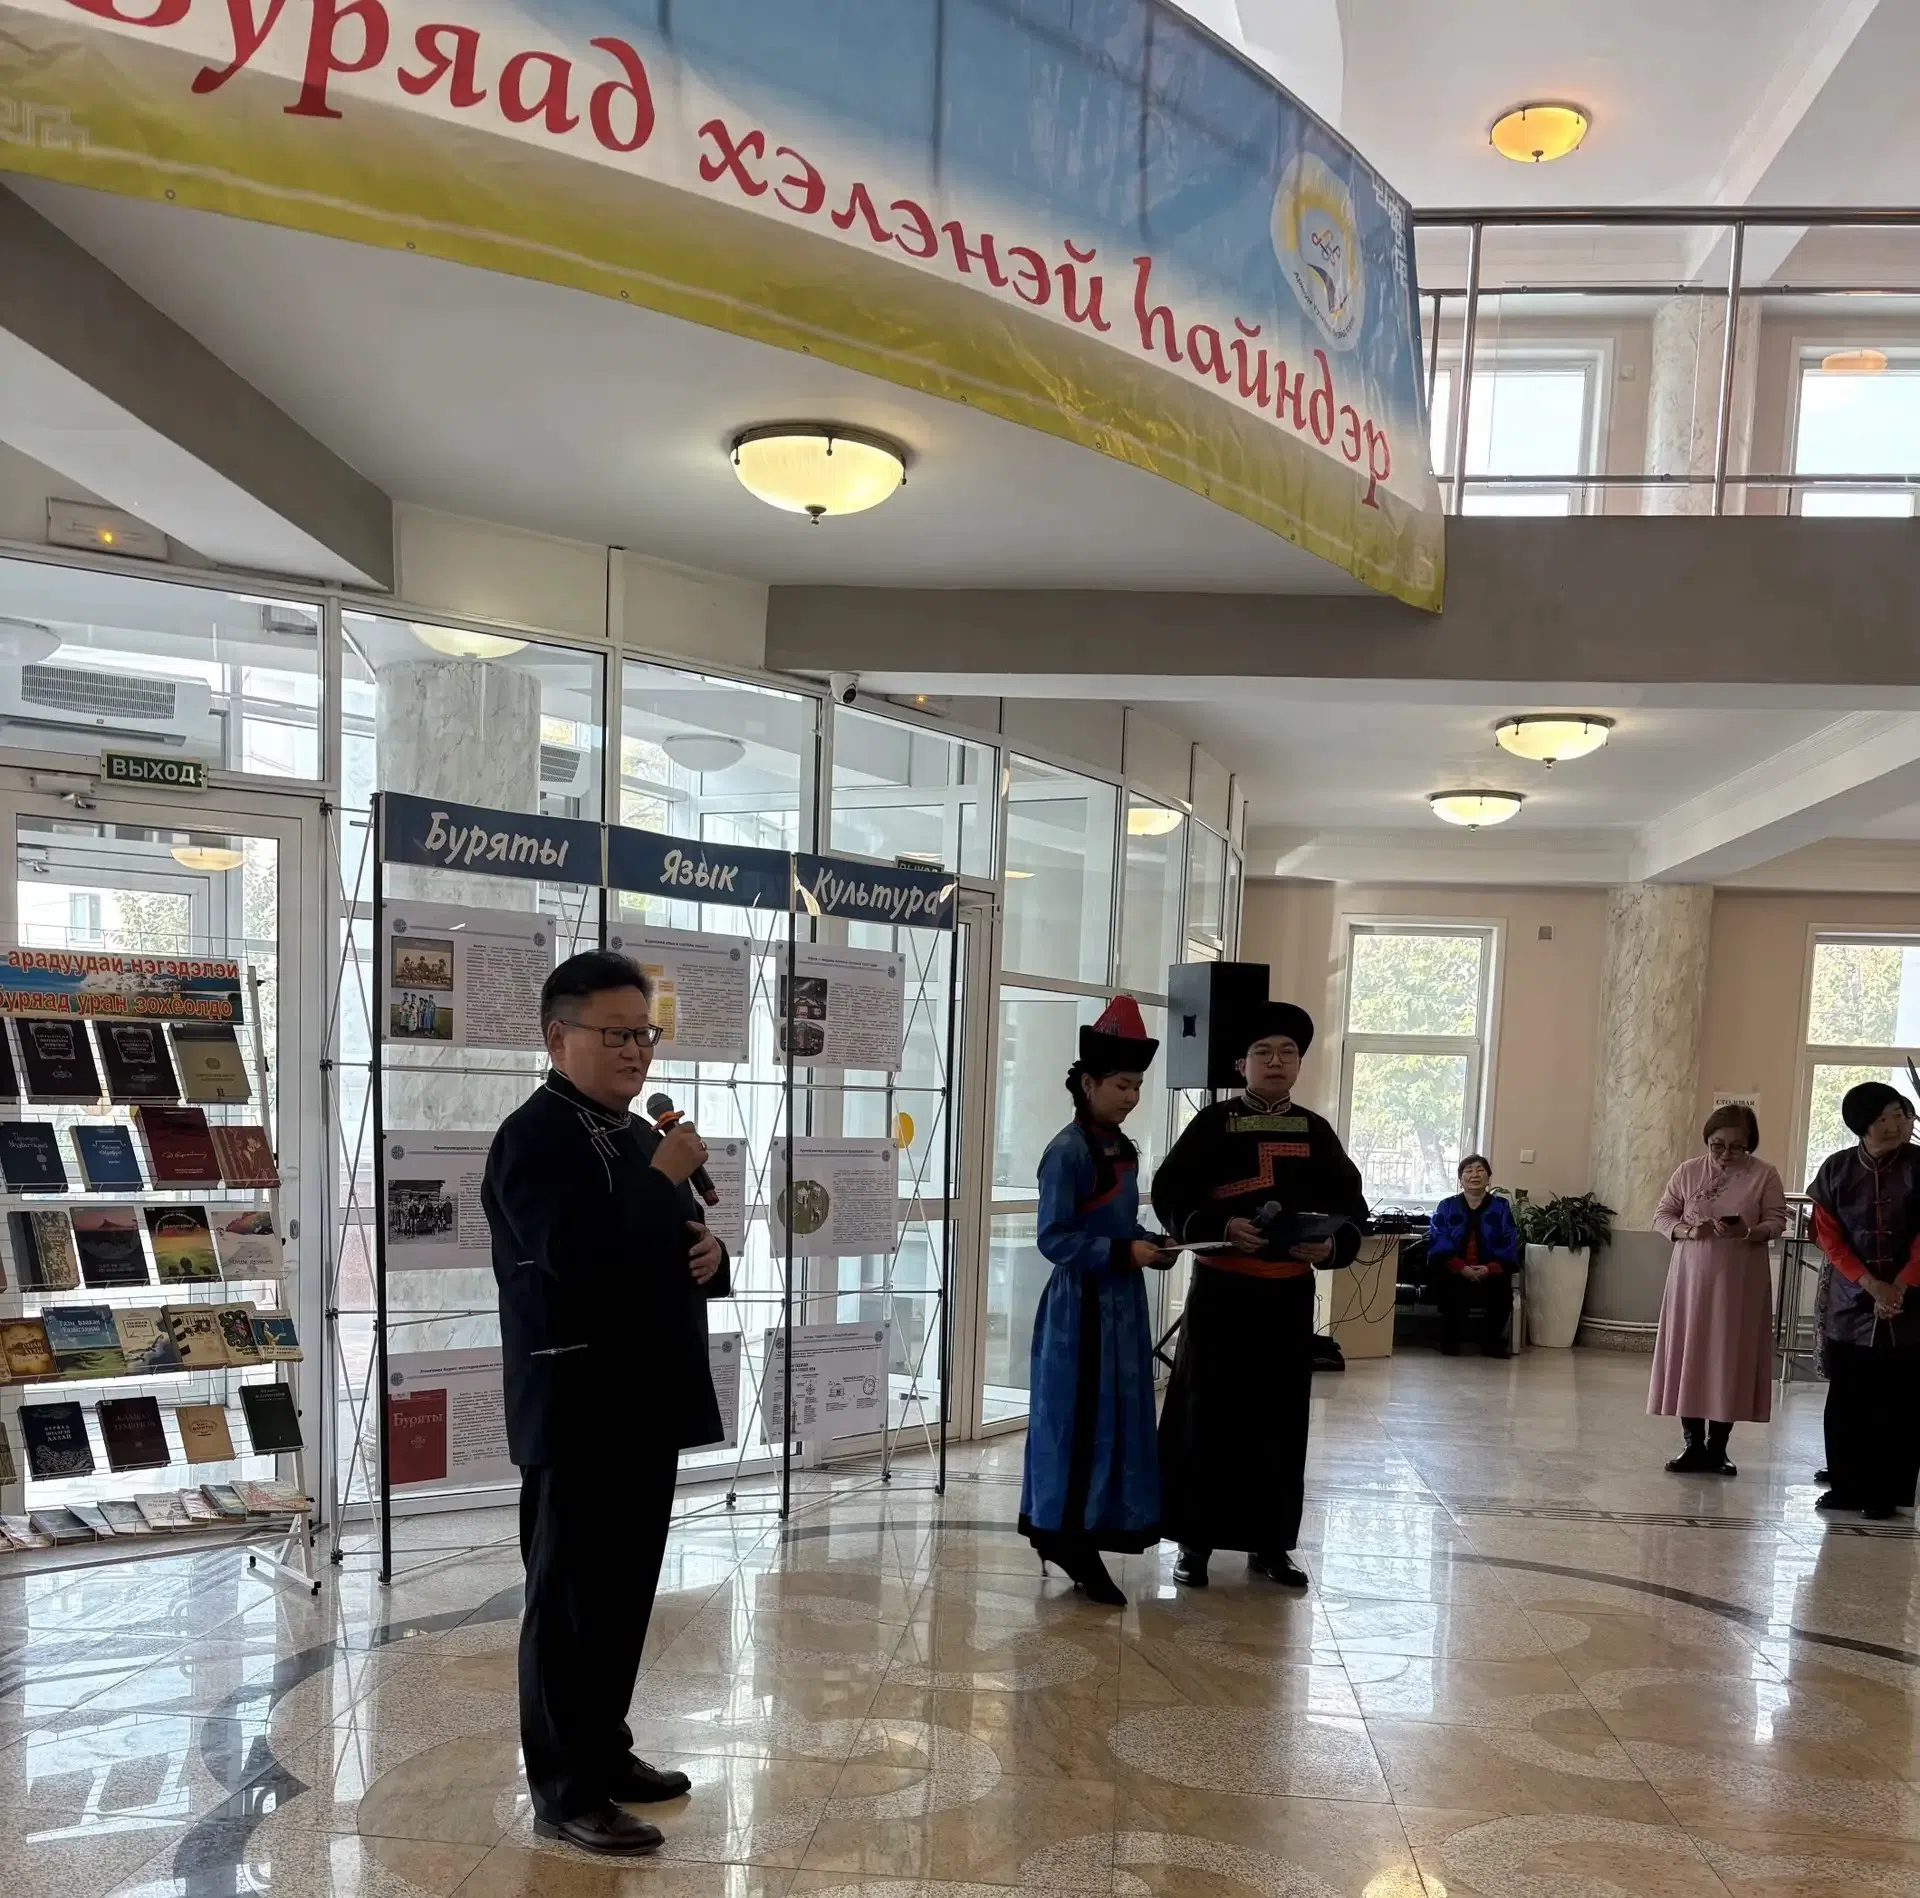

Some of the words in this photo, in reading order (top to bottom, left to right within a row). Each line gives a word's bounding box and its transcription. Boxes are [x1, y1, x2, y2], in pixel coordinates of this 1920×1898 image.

[62, 0, 655, 153] уряад
[698, 119, 1112, 332] хэлэнэй
[112, 758, 196, 784] ВЫХОД
[424, 811, 568, 868] Буряты
[660, 849, 739, 892] Язык
[812, 867, 940, 921] Культура
[131, 958, 239, 980] нэгэдэлэй
[77, 992, 129, 1016] уран
[135, 993, 233, 1019] зохёолдо
[393, 1412, 443, 1429] Буряты
